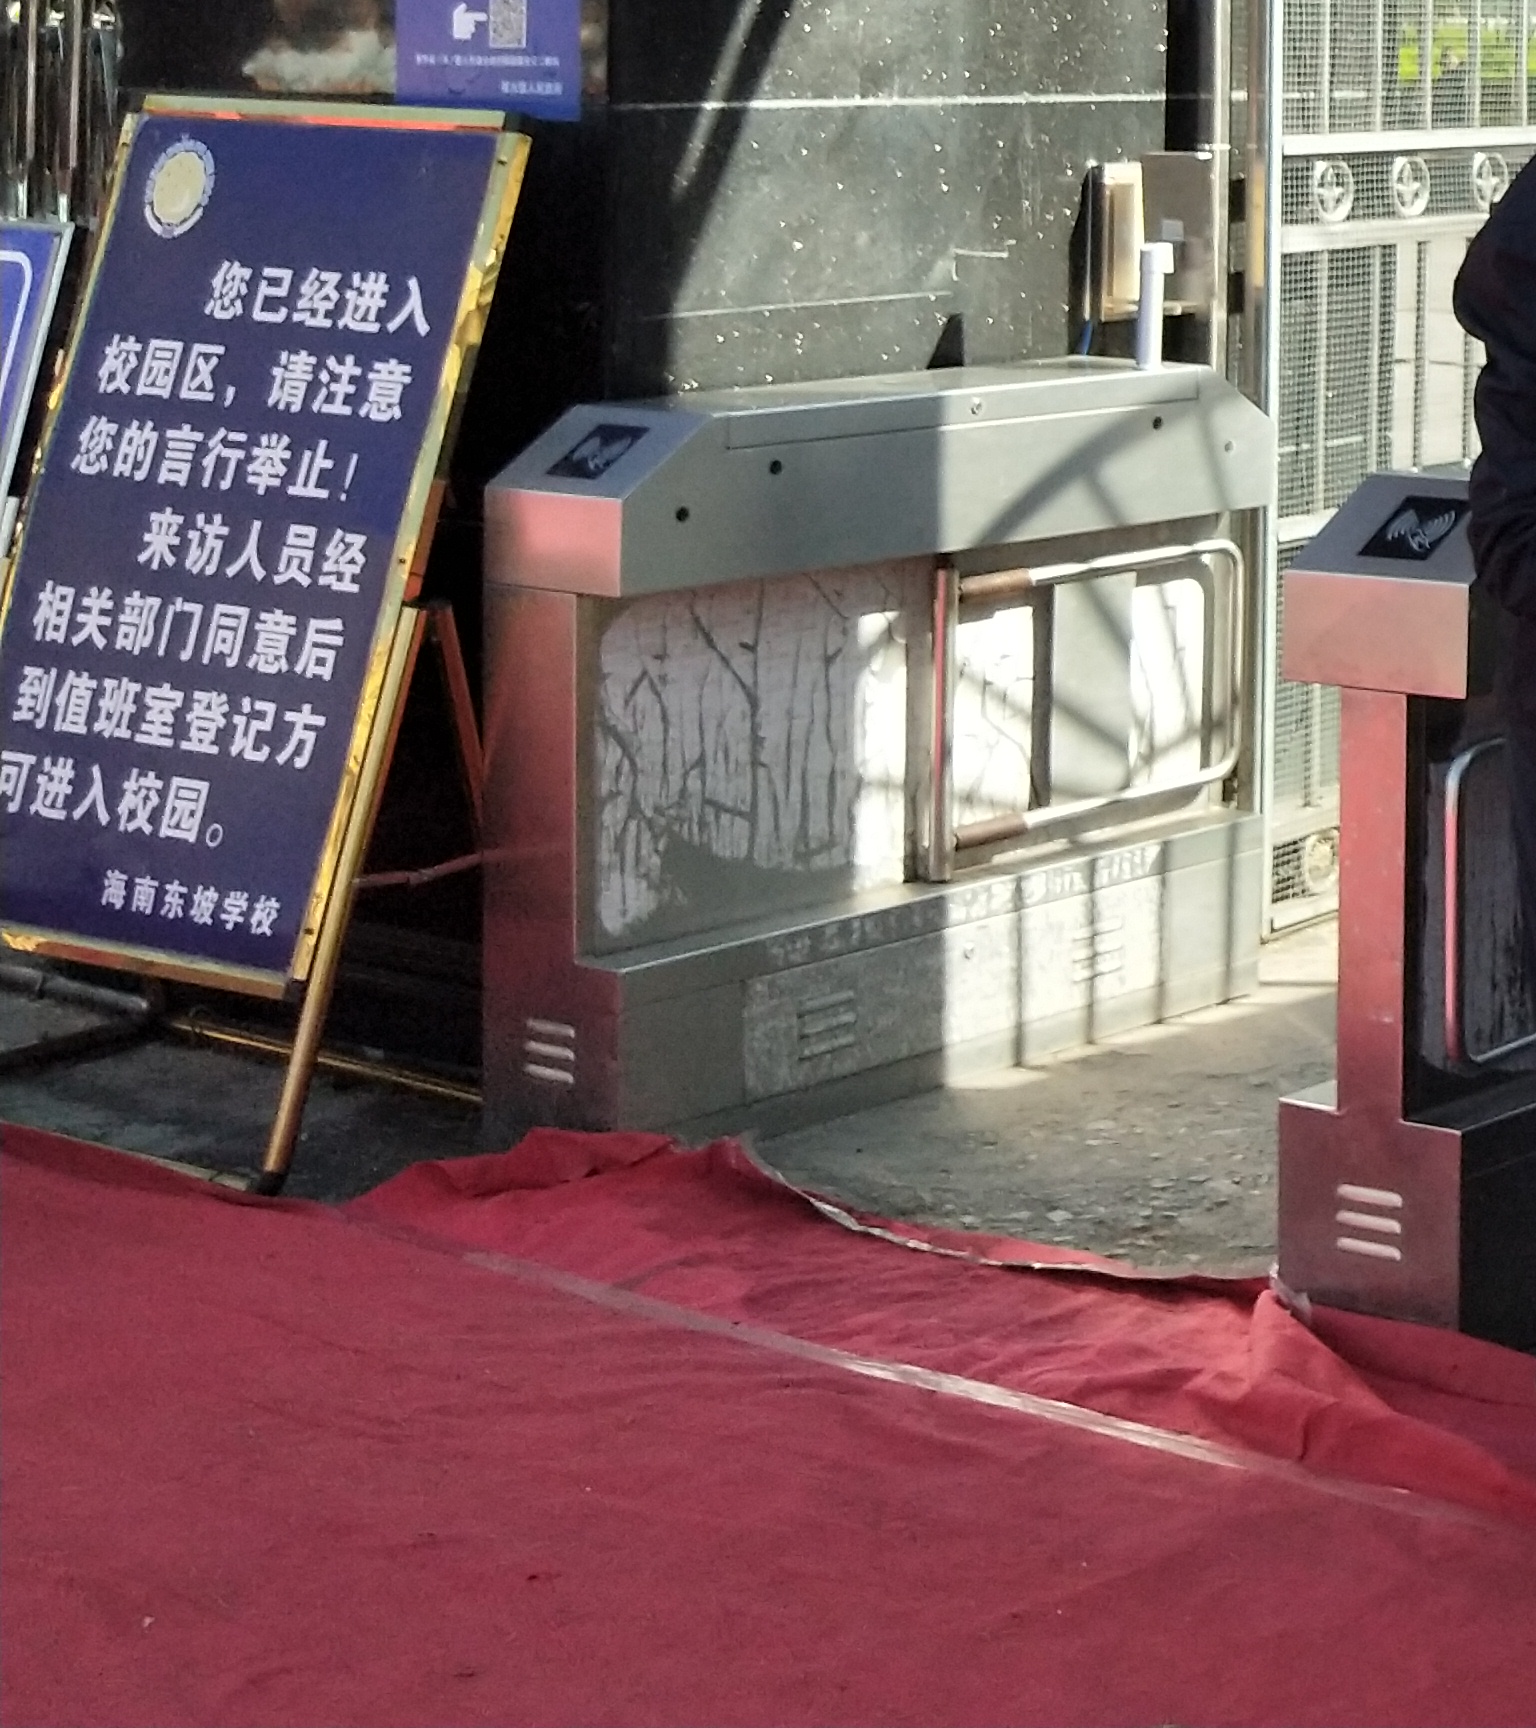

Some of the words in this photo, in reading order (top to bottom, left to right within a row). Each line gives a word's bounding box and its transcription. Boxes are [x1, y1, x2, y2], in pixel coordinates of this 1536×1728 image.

[204, 259, 431, 337] 您已经进入
[98, 334, 412, 422] 校园区，请注意
[137, 506, 368, 593] 来访人员经
[33, 579, 345, 682] 相关部门同意后
[12, 665, 327, 770] 到值班室登记方
[0, 749, 224, 848] 可进入校园。
[101, 869, 281, 937] 海南东坡学校
